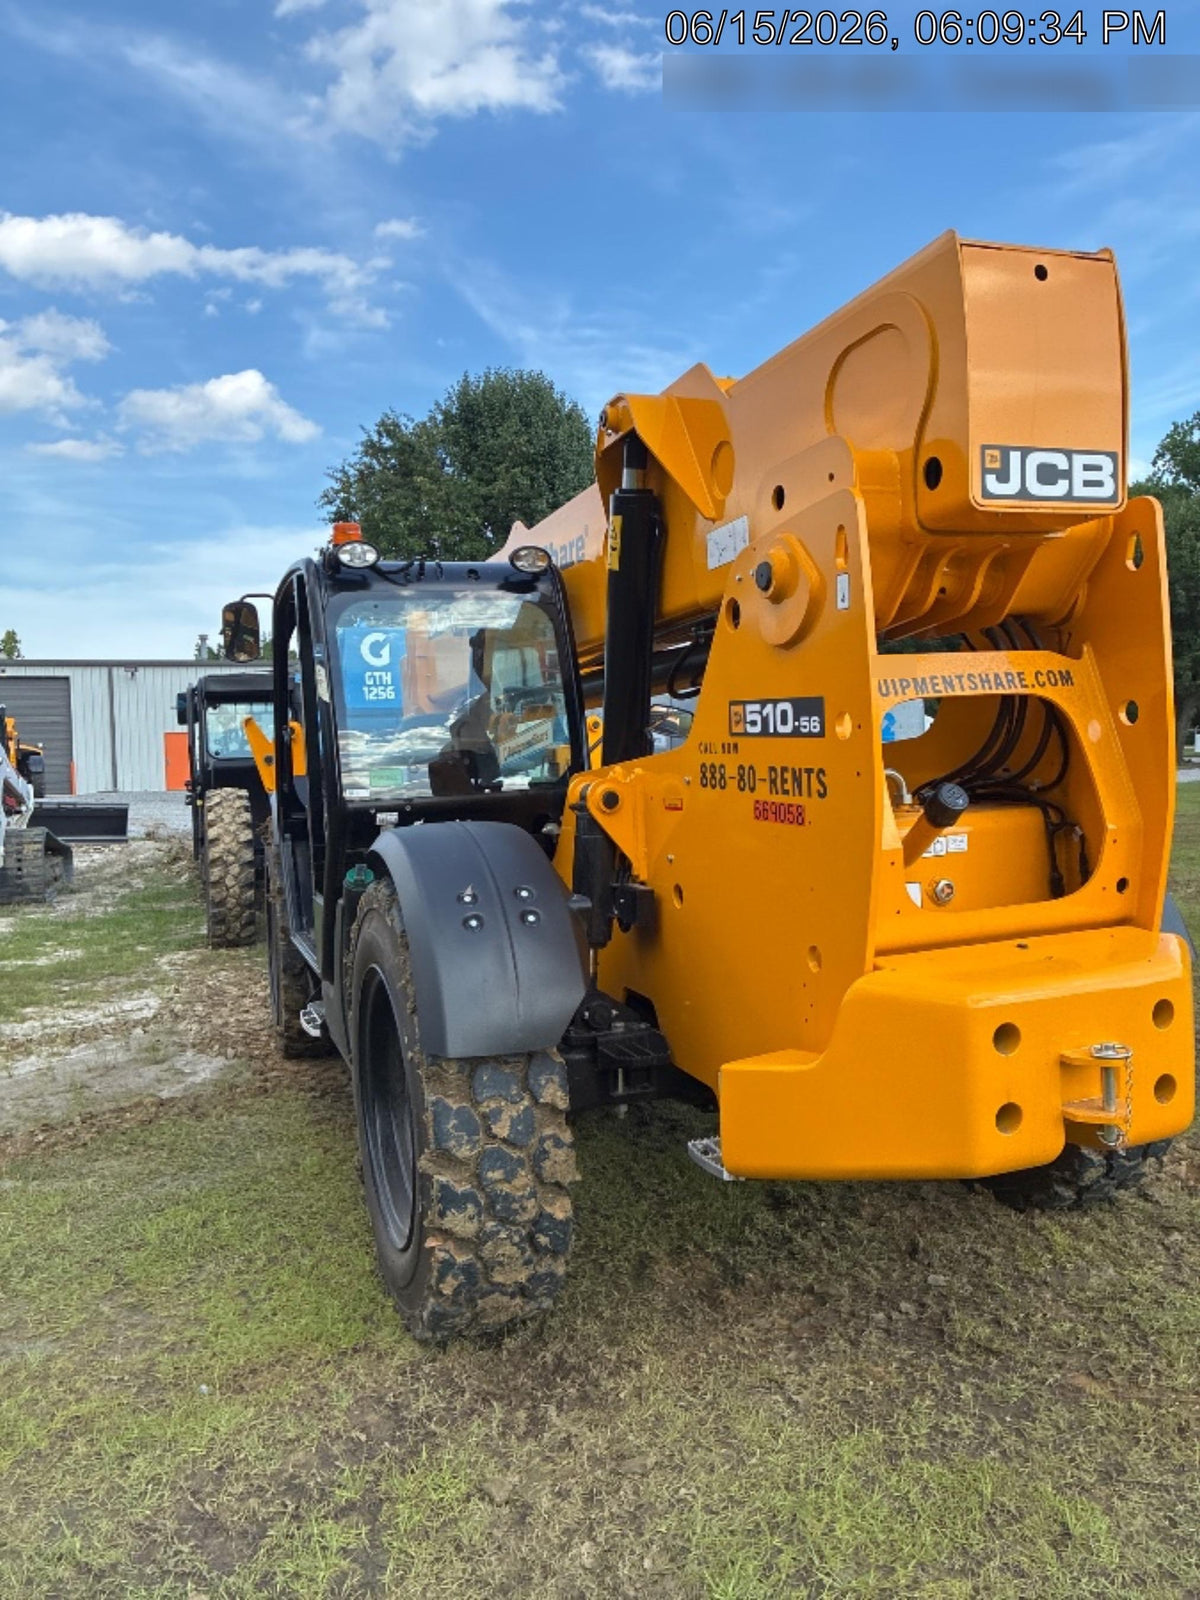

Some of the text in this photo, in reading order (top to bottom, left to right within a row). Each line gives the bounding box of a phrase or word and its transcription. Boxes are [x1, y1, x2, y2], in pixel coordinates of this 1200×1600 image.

[985, 450, 1116, 498] JCB
[364, 671, 392, 685] GTH
[363, 686, 396, 701] 1256
[700, 762, 828, 800] 888-80-RENTS
[754, 800, 805, 826] 669058
